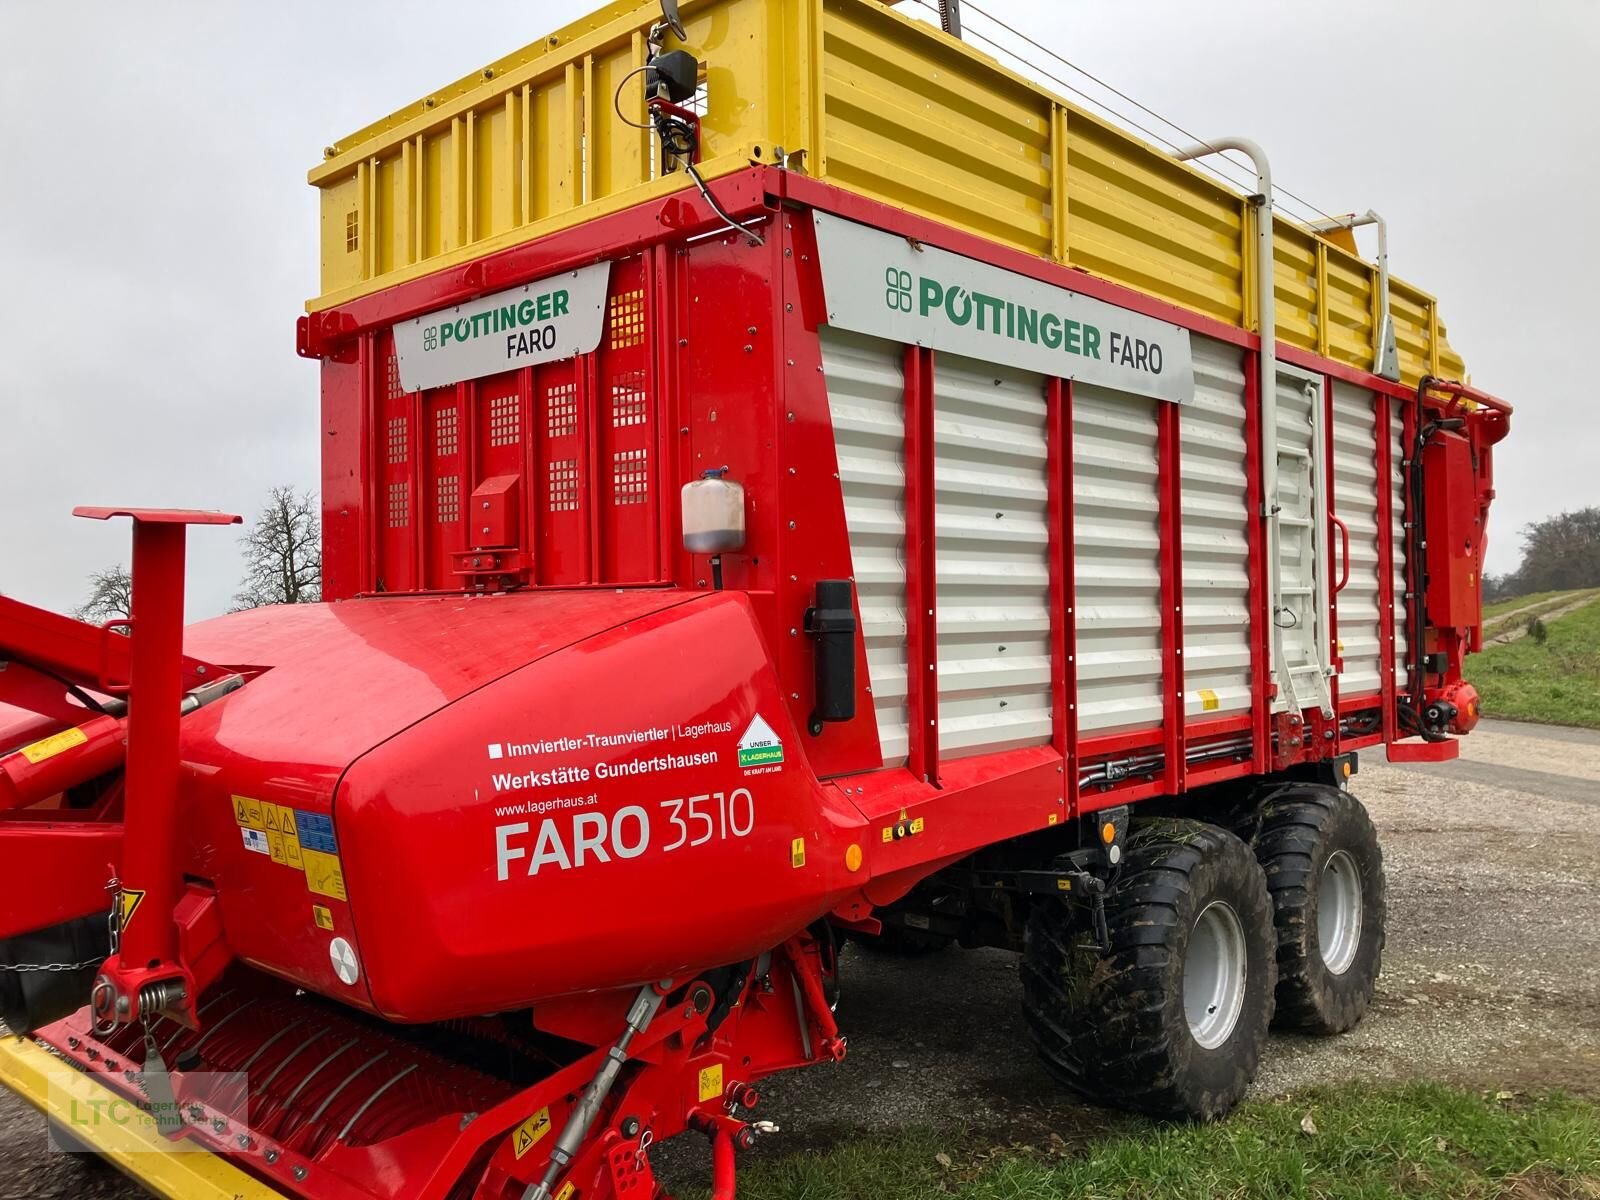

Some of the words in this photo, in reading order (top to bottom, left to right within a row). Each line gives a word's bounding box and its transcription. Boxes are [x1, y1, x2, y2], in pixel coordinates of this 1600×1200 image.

[440, 290, 569, 347] PÖTTINGER
[919, 277, 1101, 360] PÖTTINGER
[1110, 331, 1163, 374] FARO
[507, 325, 556, 359] FARO
[507, 729, 669, 757] Innviertler-Traunviertler
[678, 720, 732, 739] Lagerhaus
[492, 769, 590, 791] Werkstätte
[595, 750, 718, 779] Gundertshausen
[495, 793, 598, 817] www.lagerhaus.at
[495, 805, 650, 881] FARO
[660, 787, 755, 851] 3510
